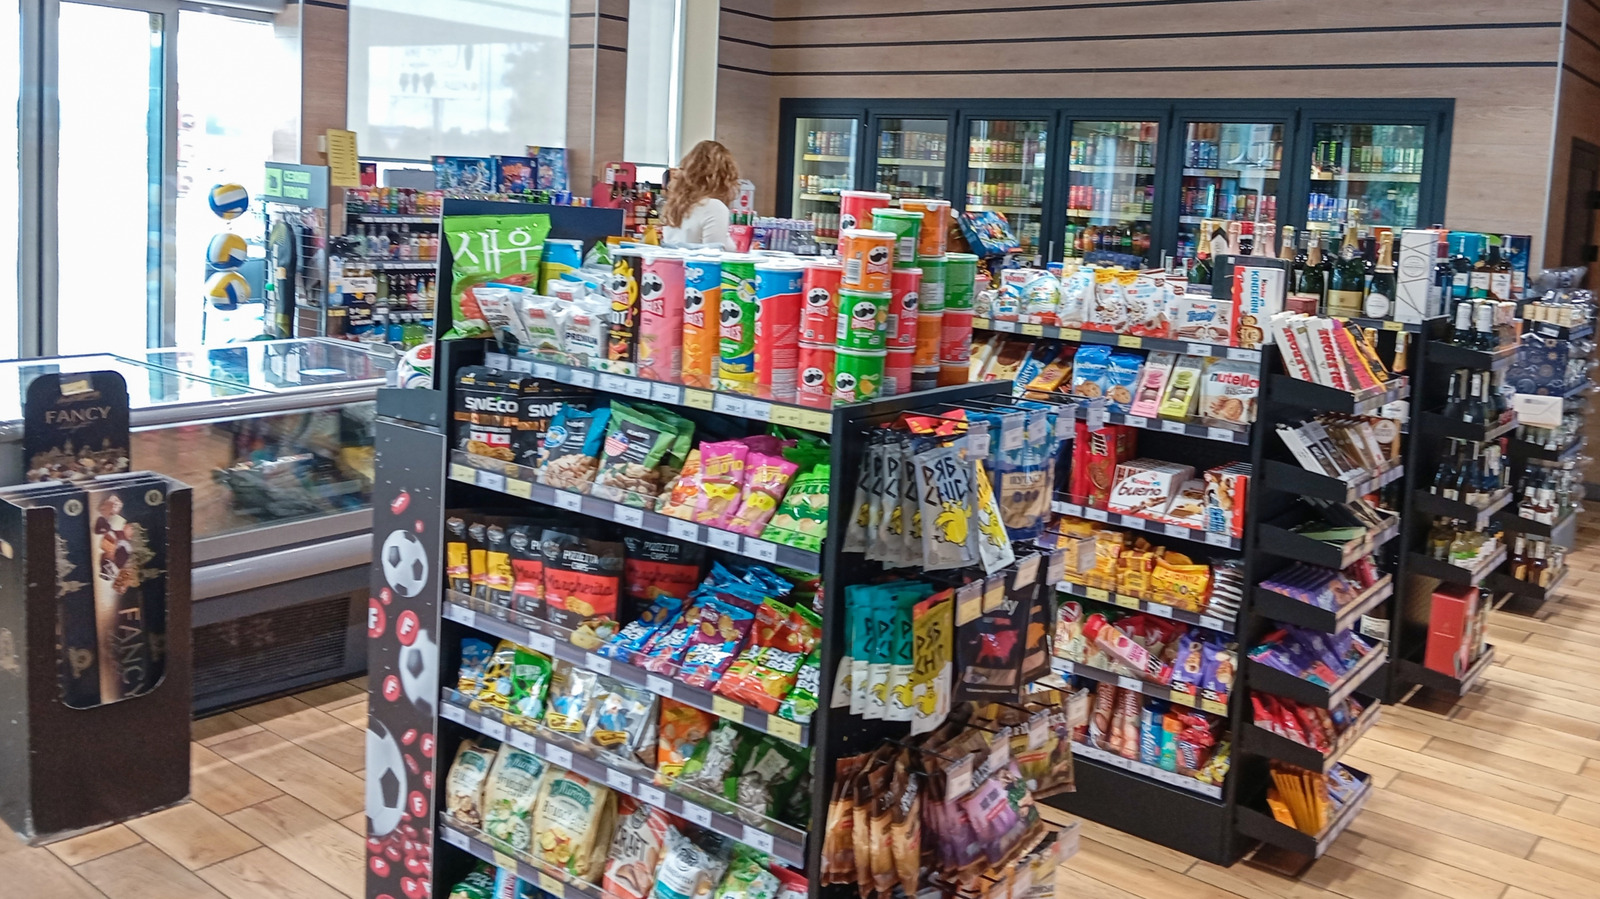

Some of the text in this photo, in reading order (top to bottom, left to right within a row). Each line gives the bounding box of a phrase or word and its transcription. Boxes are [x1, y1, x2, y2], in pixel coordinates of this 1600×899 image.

[452, 226, 545, 274] 새우
[1251, 270, 1259, 313] KINDERINI
[1210, 372, 1259, 388] nutella
[465, 396, 519, 414] SNECO
[45, 406, 111, 424] FANCY
[1118, 482, 1162, 496] bueno
[400, 617, 414, 635] F
[118, 607, 146, 697] FANCY
[385, 680, 397, 695] F
[413, 796, 422, 812] F
